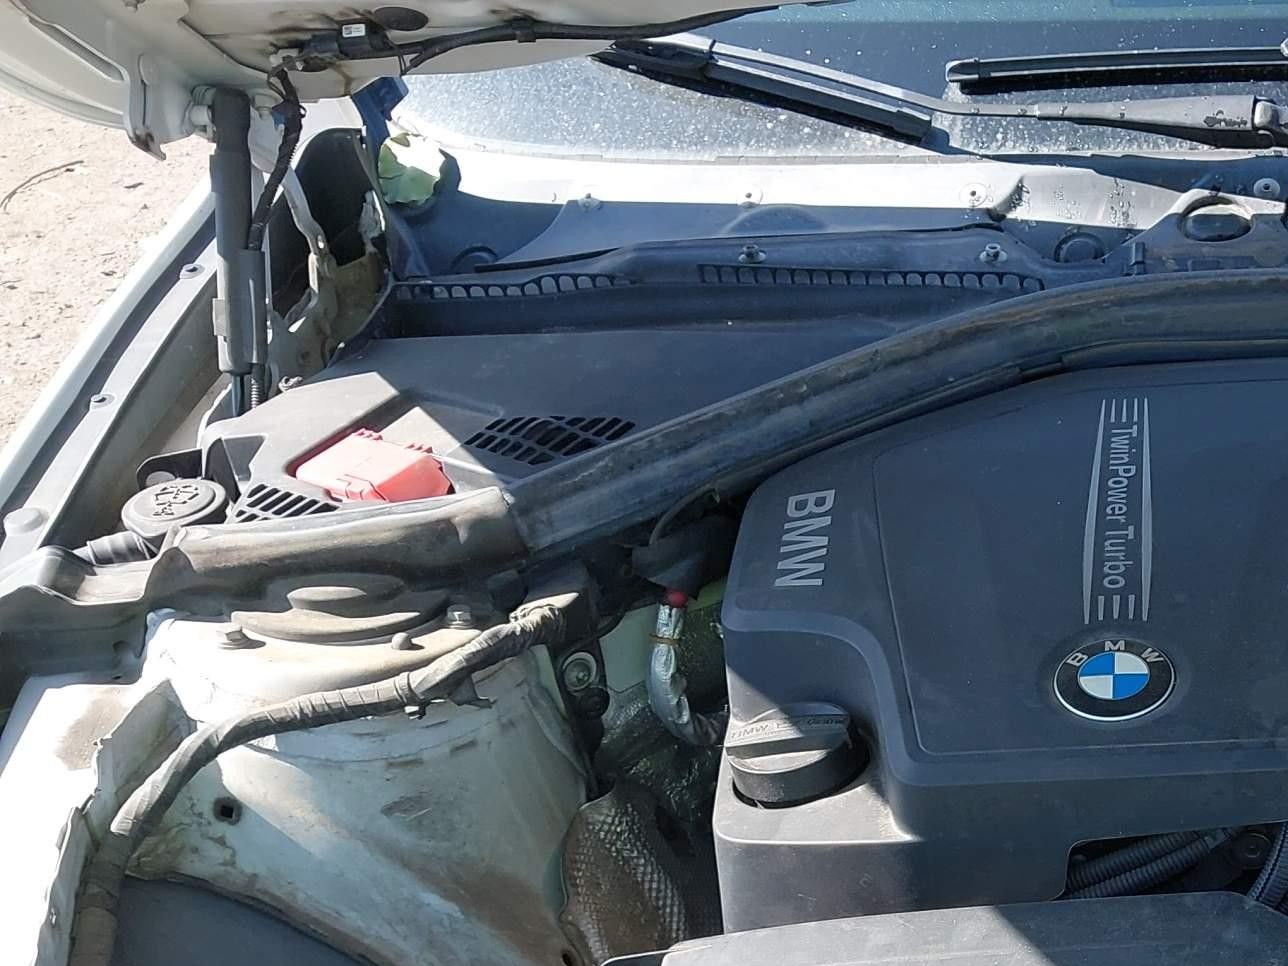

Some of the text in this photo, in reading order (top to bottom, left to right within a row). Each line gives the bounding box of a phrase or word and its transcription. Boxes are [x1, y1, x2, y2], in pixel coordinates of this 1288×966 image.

[774, 489, 836, 587] BMW
[1102, 424, 1138, 589] TwinPower Turbo
[1065, 639, 1165, 667] BMW
